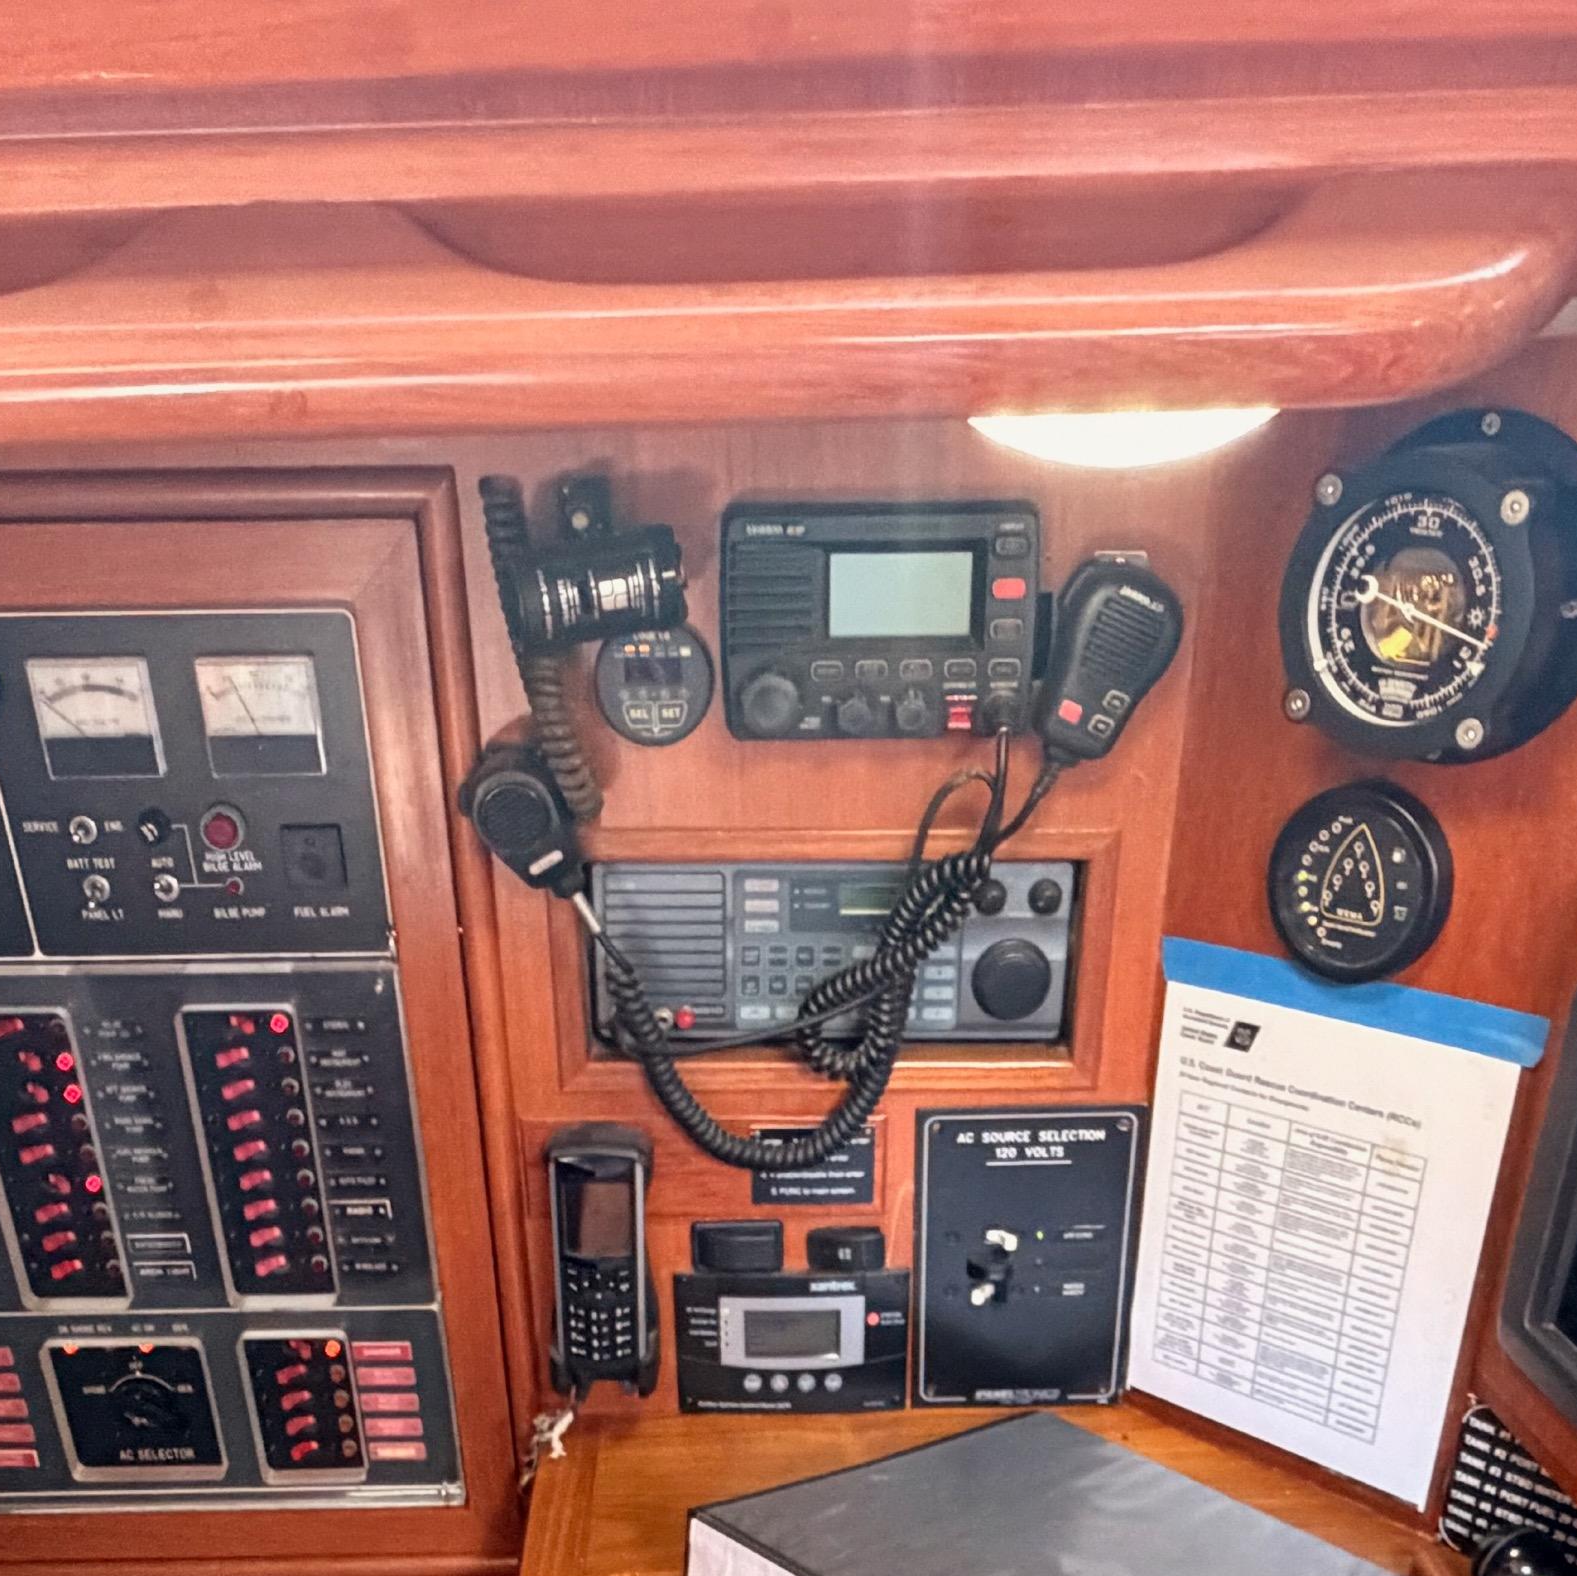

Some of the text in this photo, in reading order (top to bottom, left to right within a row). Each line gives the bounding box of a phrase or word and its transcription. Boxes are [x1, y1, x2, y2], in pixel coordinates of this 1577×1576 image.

[1417, 515, 1441, 529] 30
[661, 707, 681, 719] SET
[66, 857, 115, 870] BATT TEST
[229, 851, 256, 862] LEVEL
[233, 861, 263, 872] ALARM
[294, 906, 349, 918] FUEL ALARM
[1198, 1061, 1224, 1076] Coast
[1225, 1067, 1253, 1083] Guard
[1254, 1074, 1287, 1093] Rescue
[1288, 1085, 1347, 1109] Coordination
[1348, 1101, 1385, 1119] Centers
[956, 1129, 1106, 1144] AC SOURCE SELECTION
[995, 1146, 1064, 1158] 120 VOLTS
[1468, 1416, 1496, 1436] TANK
[137, 1447, 196, 1460] SELECTOR
[1464, 1433, 1491, 1453] TANK
[1509, 1453, 1539, 1473] PORT
[1459, 1451, 1487, 1471] TANK
[1504, 1471, 1534, 1491] STBD
[1450, 1488, 1476, 1507] TANK
[1454, 1470, 1481, 1489] TANK
[1499, 1489, 1530, 1508] PORT
[1529, 1502, 1556, 1520] FUEL
[1447, 1504, 1473, 1522] TANK
